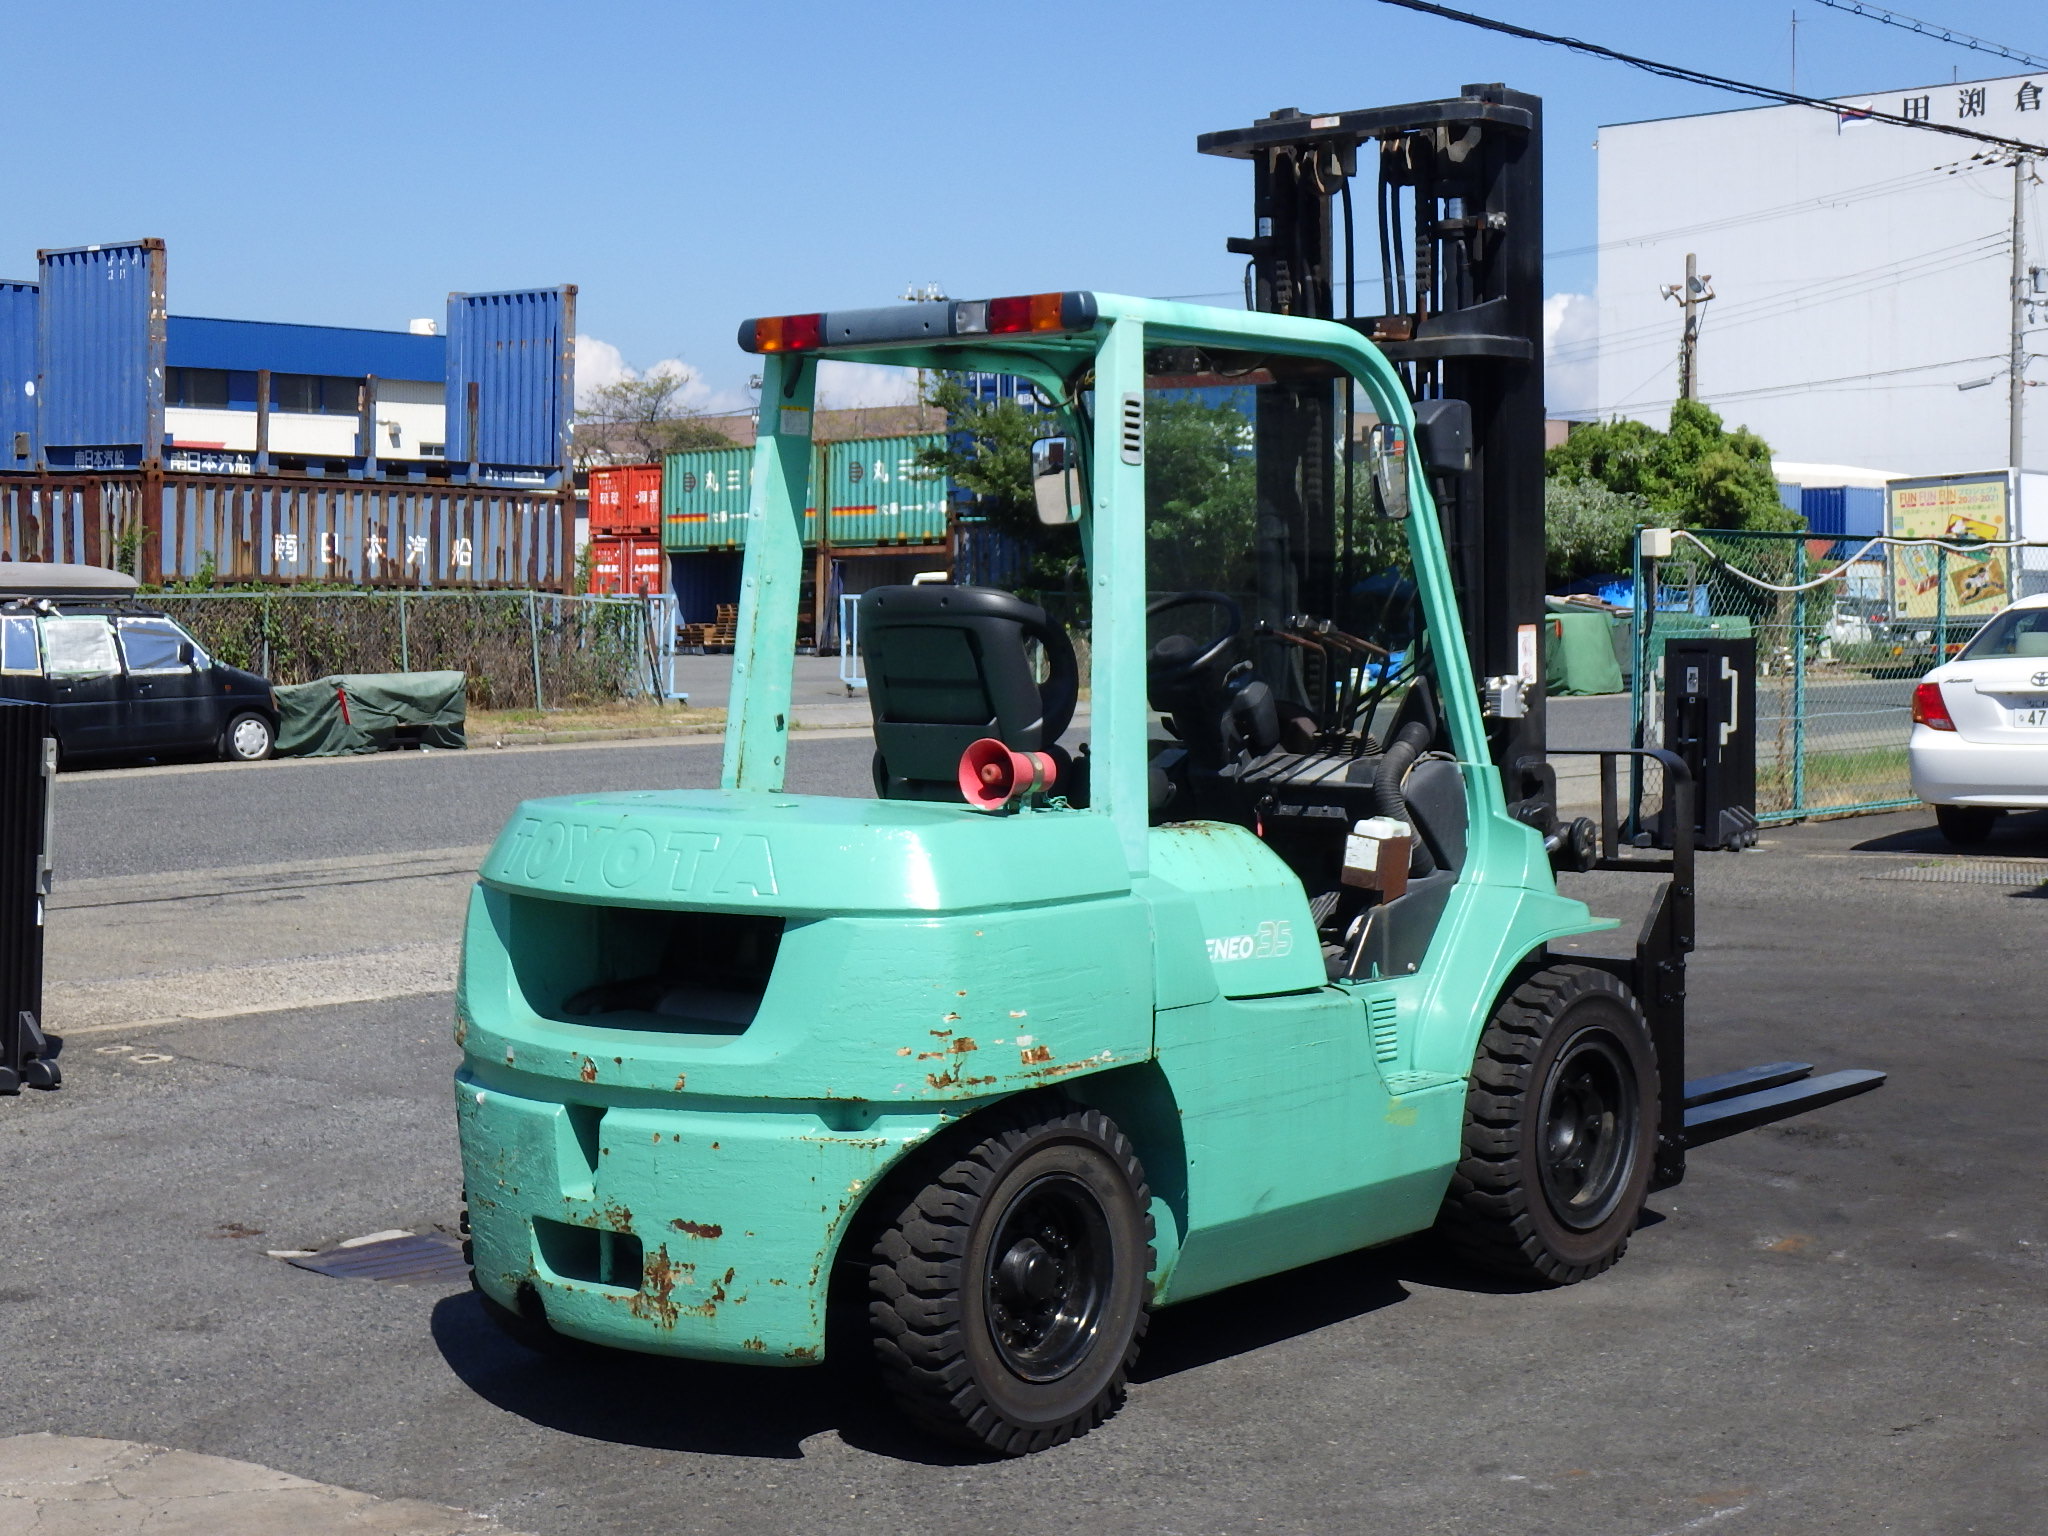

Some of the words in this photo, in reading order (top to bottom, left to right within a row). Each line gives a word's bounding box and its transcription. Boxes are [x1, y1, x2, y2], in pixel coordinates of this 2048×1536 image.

[75, 450, 125, 469] 南日本汽船
[170, 450, 251, 473] 南日本汽船
[1900, 492, 1917, 504] FUN
[1919, 490, 1936, 502] FUN
[1939, 488, 1956, 500] FUN
[275, 532, 472, 566] 南日本汽船
[502, 817, 780, 897] TOYOTA
